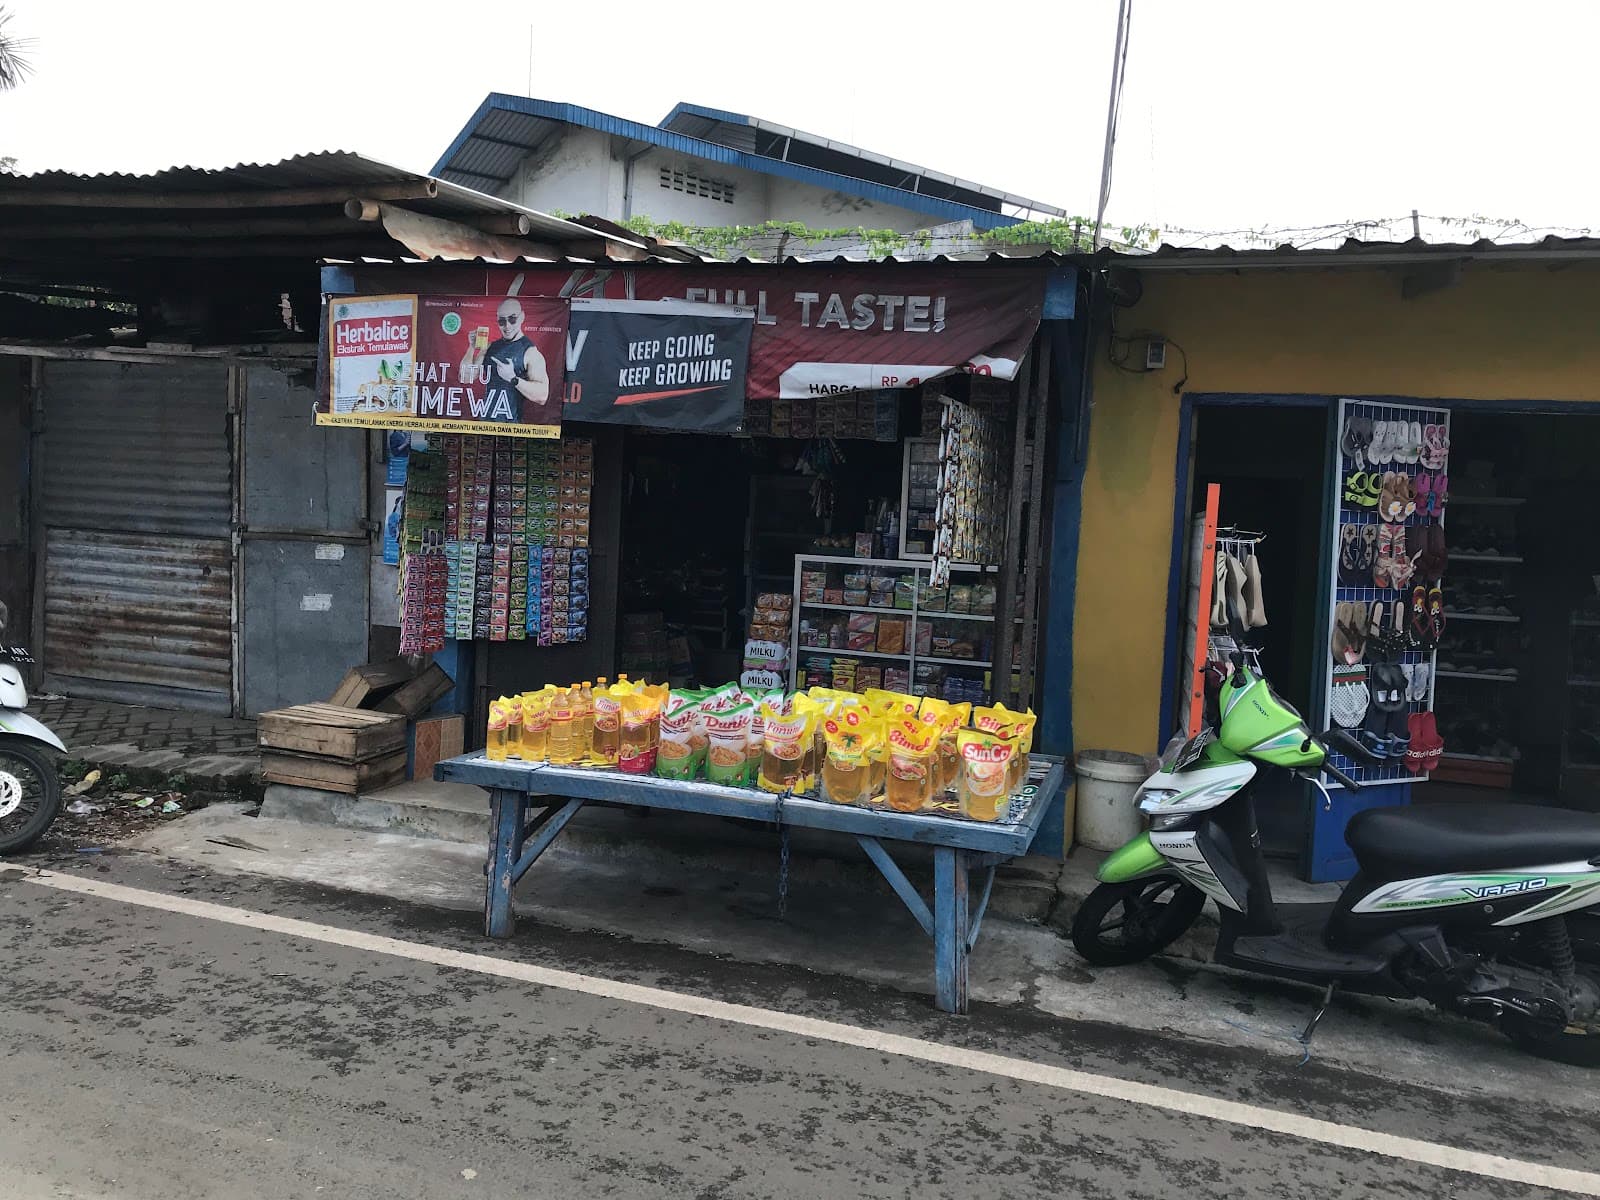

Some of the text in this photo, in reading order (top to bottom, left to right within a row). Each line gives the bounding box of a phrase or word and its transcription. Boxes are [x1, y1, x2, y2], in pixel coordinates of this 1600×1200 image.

[794, 292, 946, 333] TASTE!
[337, 320, 409, 344] Herbalice
[337, 341, 408, 354] Ekstrak Temulawak
[628, 334, 715, 361] KEEP GOING
[390, 361, 492, 385] SEHAT ITU
[619, 359, 733, 387] KEEP GROWING
[881, 376, 899, 387] RP
[366, 384, 514, 420] ISTIMEWA
[750, 647, 776, 658] MILKU
[747, 676, 773, 687] MILKU
[889, 730, 931, 752] Bimol
[964, 744, 1009, 761] SunCo
[1461, 877, 1548, 898] VARIO
